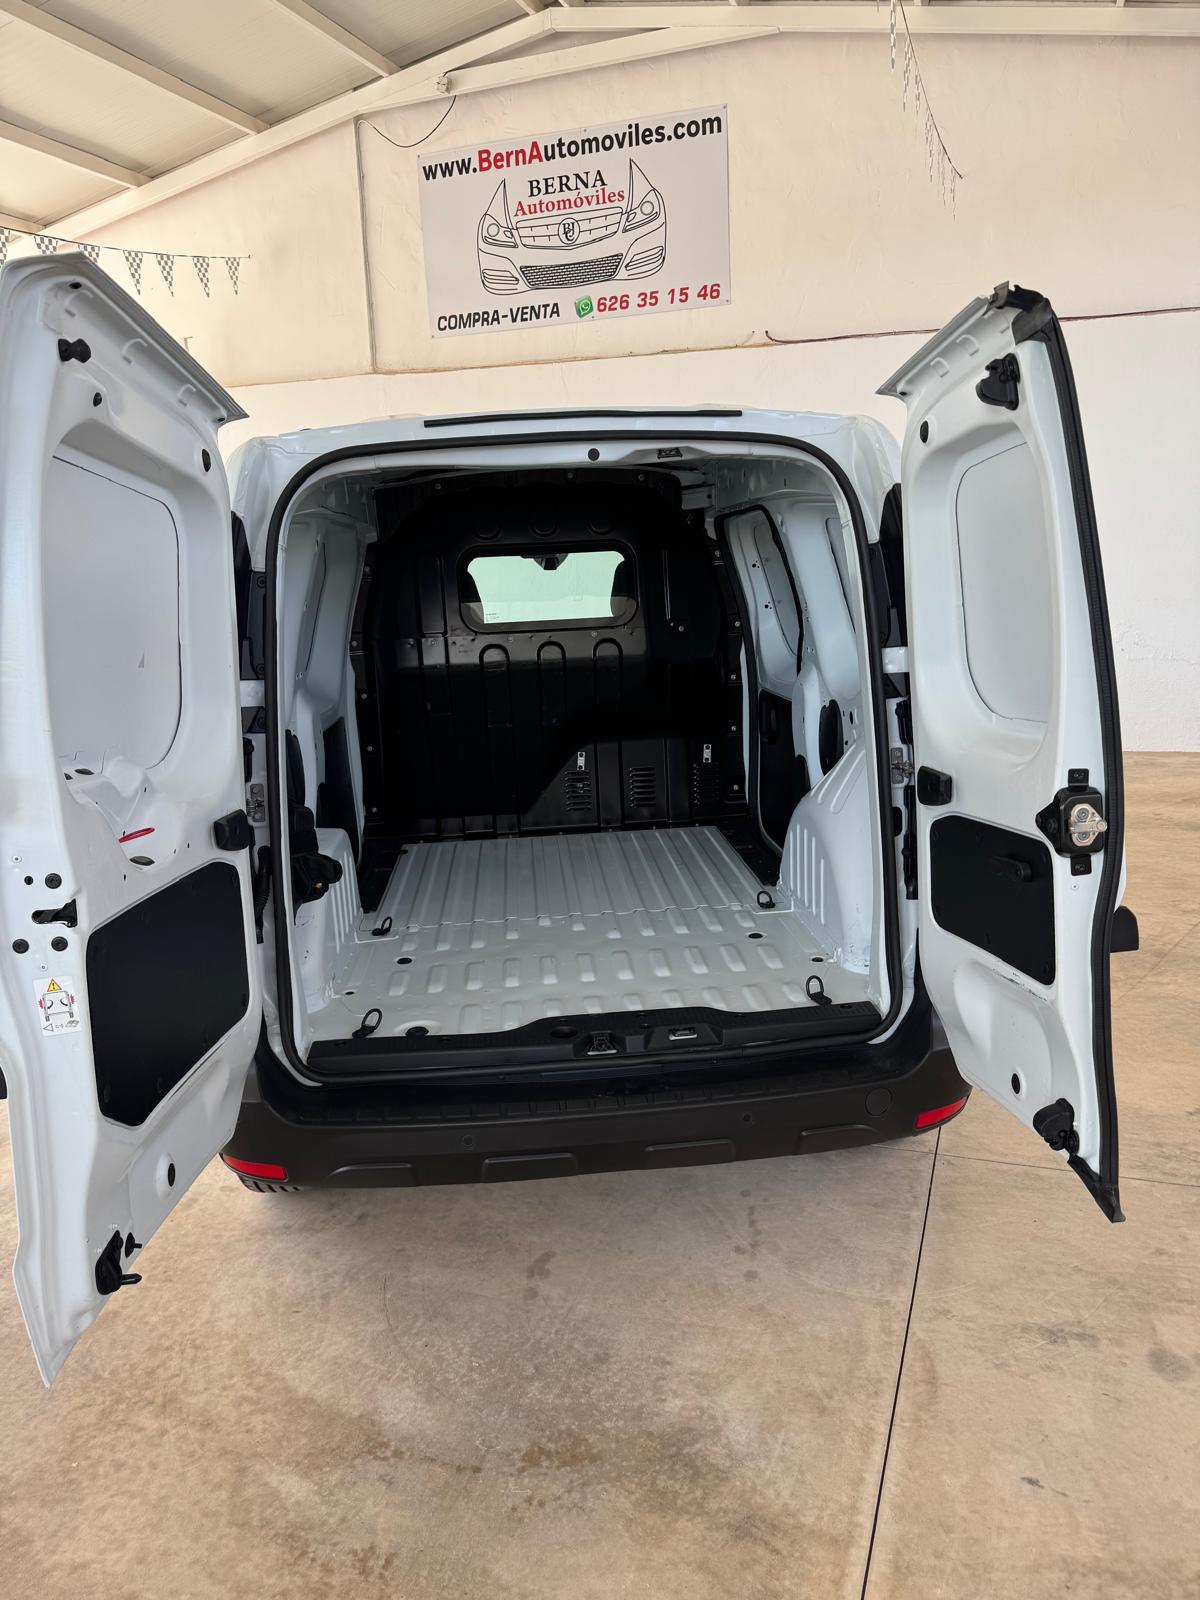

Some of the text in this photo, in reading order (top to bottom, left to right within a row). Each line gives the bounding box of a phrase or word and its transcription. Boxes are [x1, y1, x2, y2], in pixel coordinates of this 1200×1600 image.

[422, 115, 722, 181] www.BernAutomoviles.com
[528, 169, 607, 197] BERNA
[513, 188, 625, 217] Automóviles
[597, 283, 721, 313] 626 35 15 46
[437, 302, 561, 332] COMPRA-VENTA
